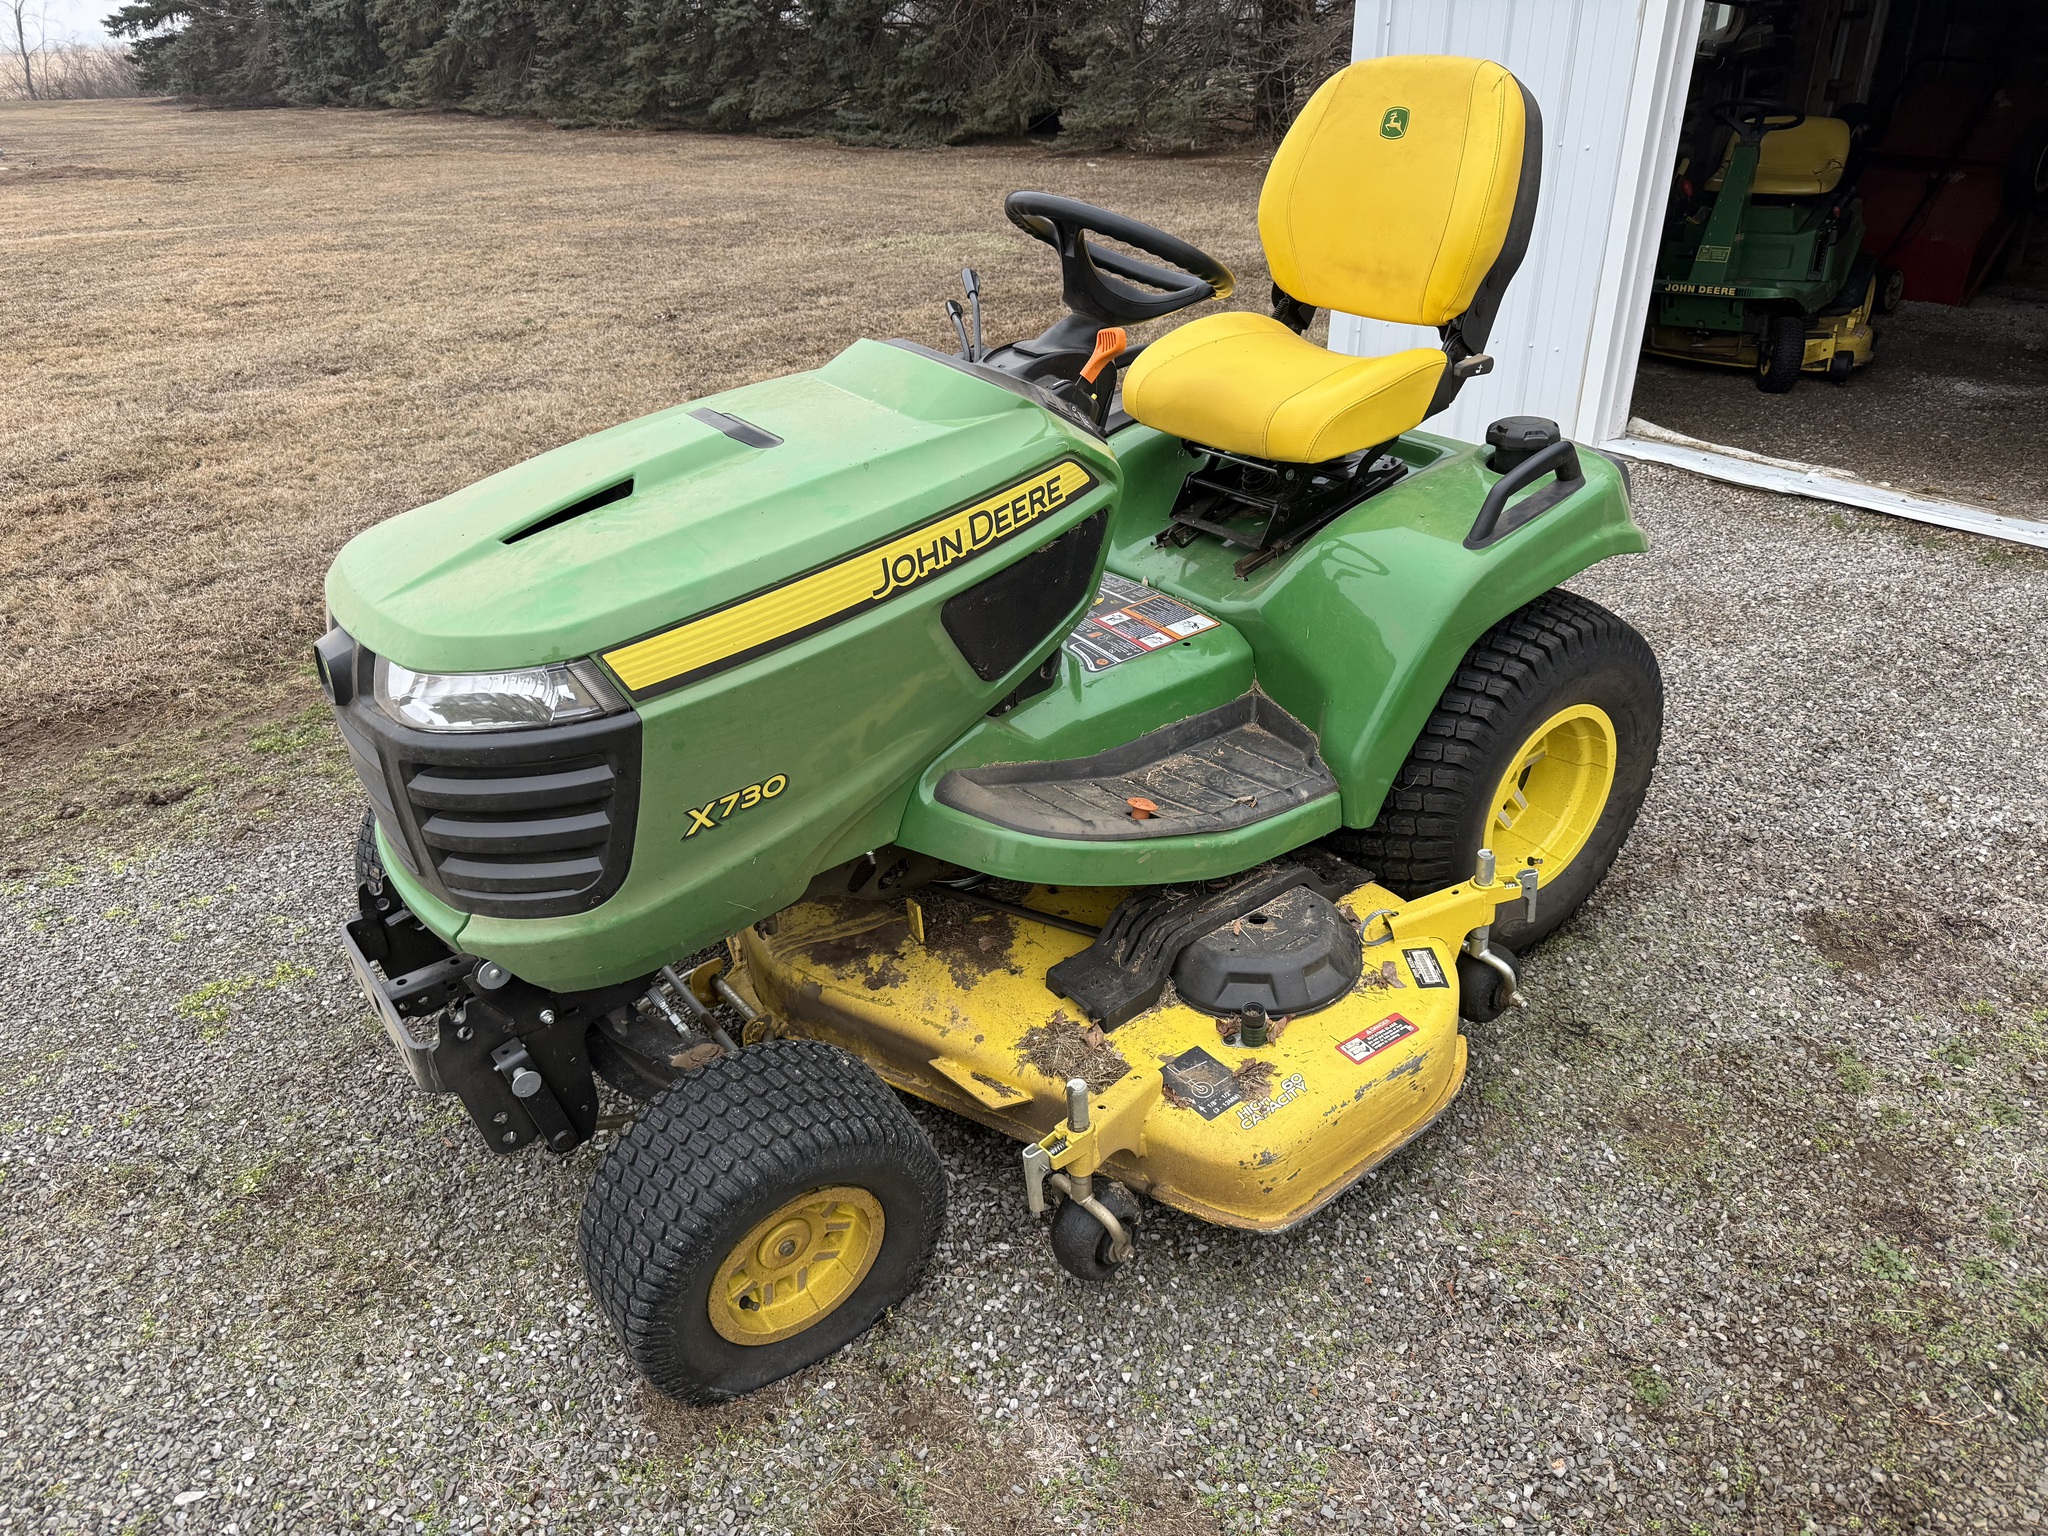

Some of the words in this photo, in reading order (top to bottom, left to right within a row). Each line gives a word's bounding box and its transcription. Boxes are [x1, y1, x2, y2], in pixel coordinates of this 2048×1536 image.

[1665, 283, 1696, 293] JOHN
[1698, 285, 1737, 296] DEERE
[872, 528, 963, 598] JOHN
[968, 474, 1066, 547] DEERE
[681, 773, 789, 840] X730
[1281, 1073, 1303, 1091] 60
